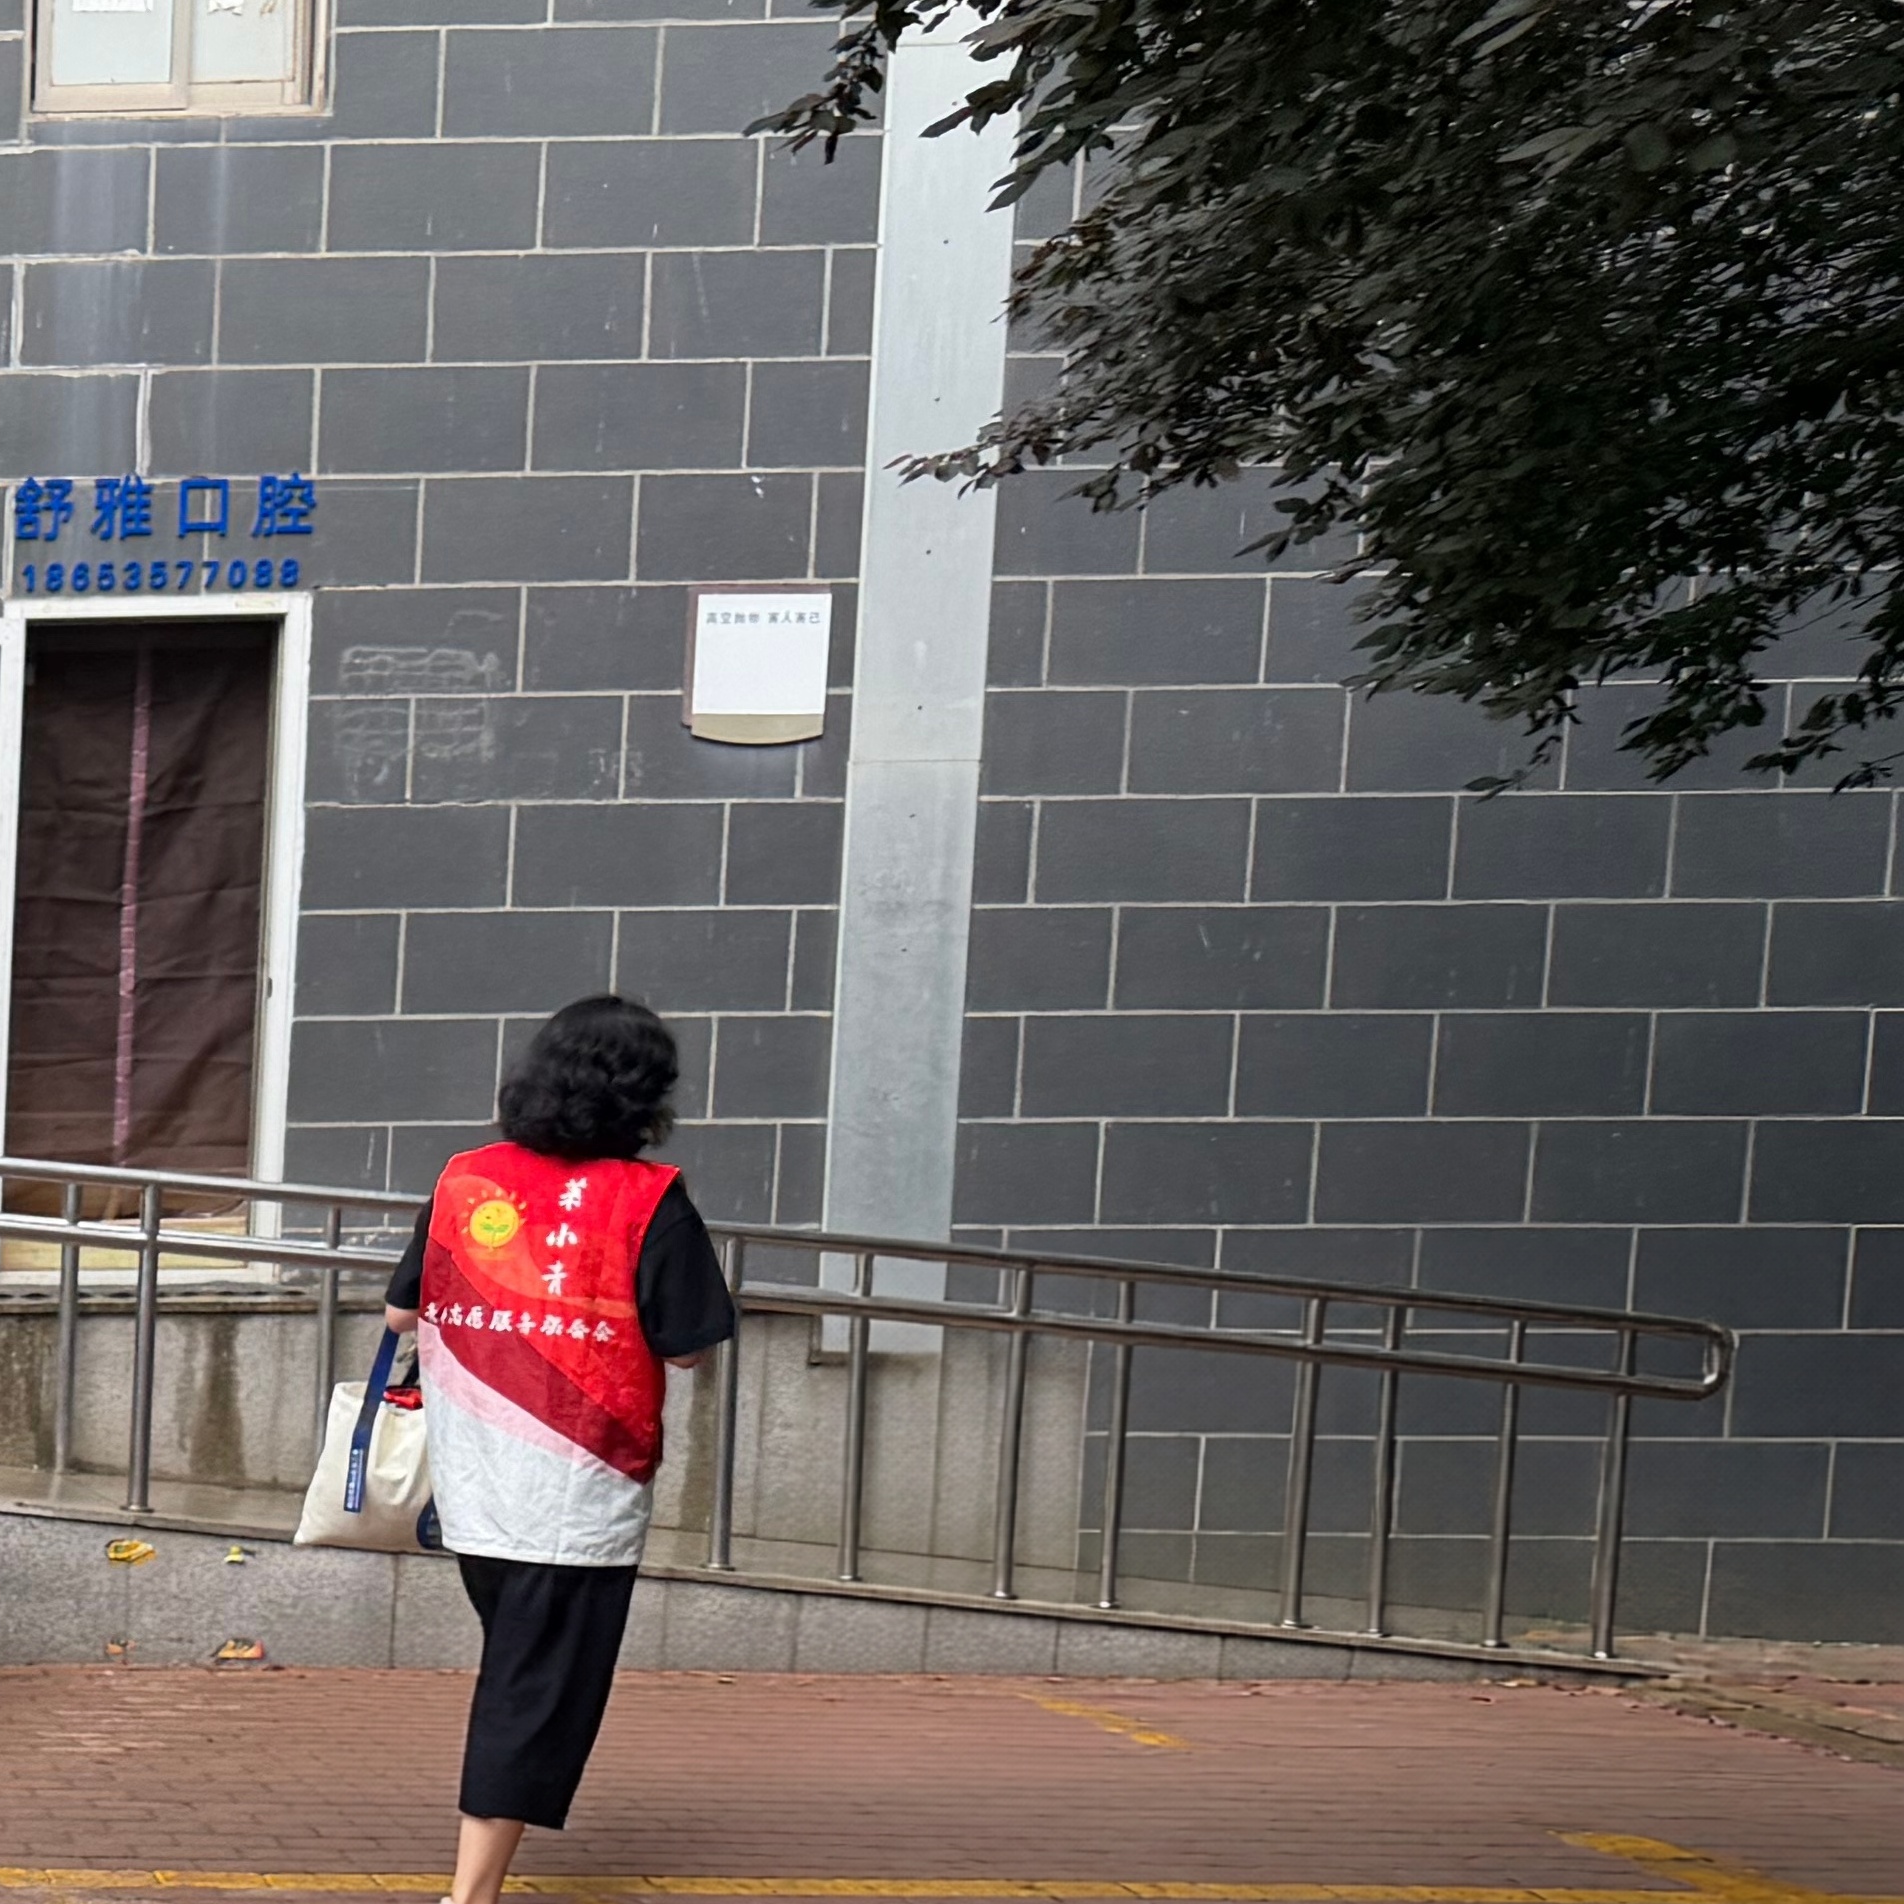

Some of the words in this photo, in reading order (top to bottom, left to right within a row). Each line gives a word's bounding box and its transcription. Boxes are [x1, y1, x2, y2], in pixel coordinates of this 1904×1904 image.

[15, 472, 317, 541] 舒雅口腔
[22, 557, 299, 593] 18653577088
